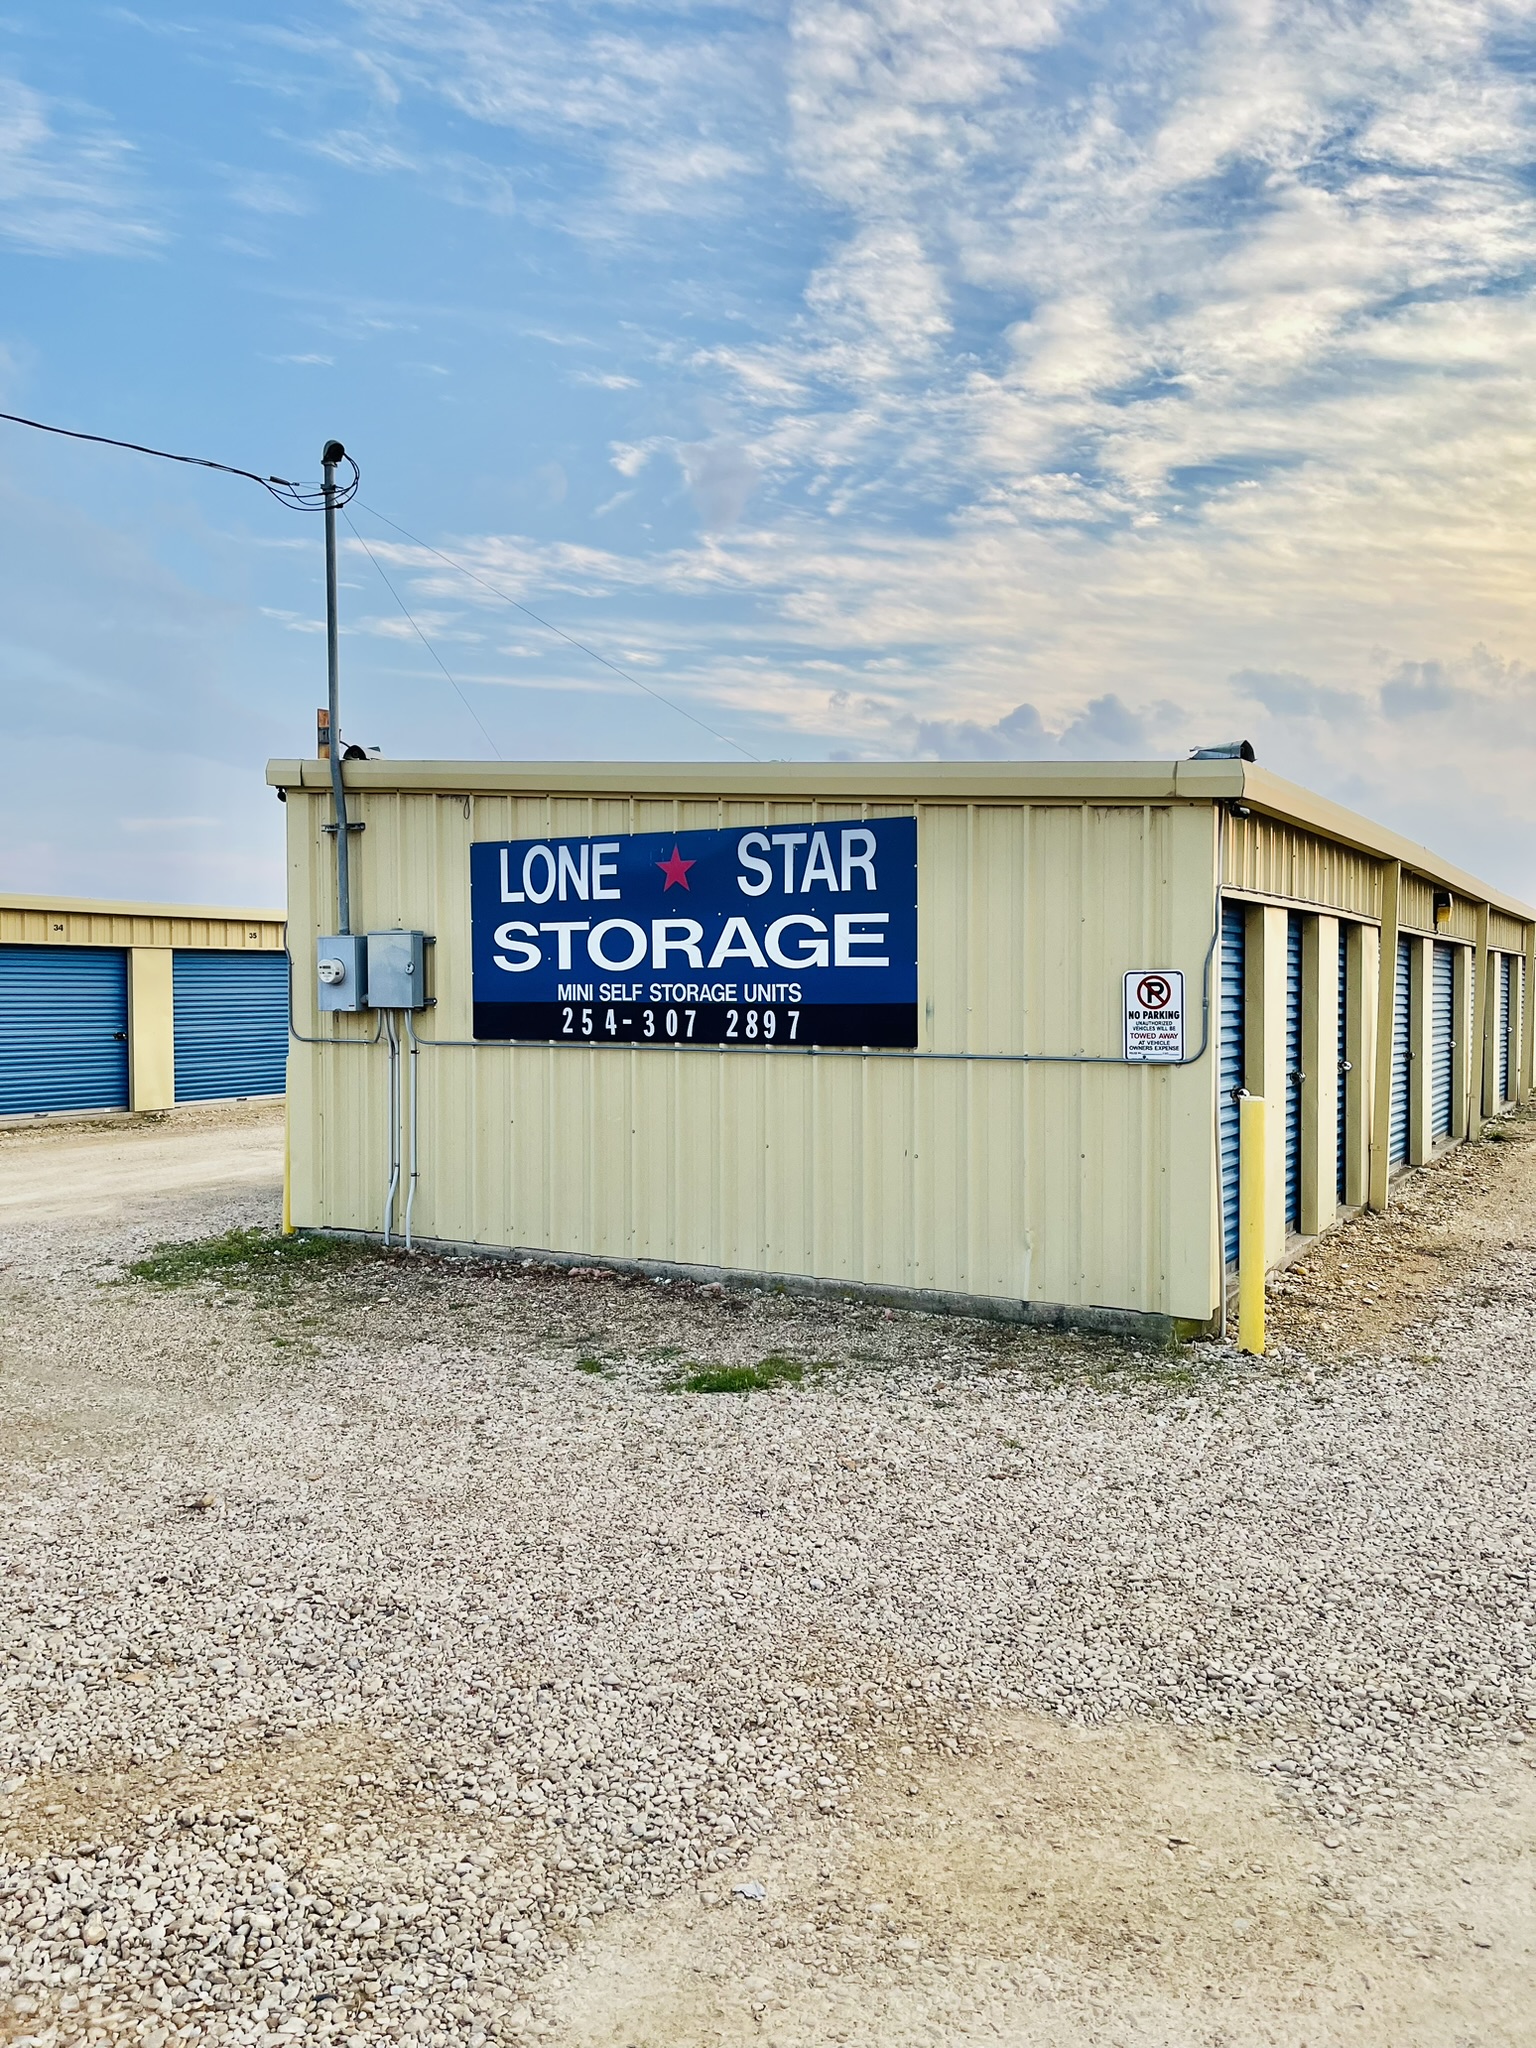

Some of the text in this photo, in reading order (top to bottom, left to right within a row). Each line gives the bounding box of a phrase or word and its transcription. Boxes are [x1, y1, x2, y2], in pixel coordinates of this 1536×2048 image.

[500, 828, 877, 904] LONE STAR
[493, 912, 890, 972] STORAGE
[557, 983, 802, 1003] MINI SELF STORAGE UNITS
[726, 1009, 801, 1040] 2897
[1128, 1011, 1180, 1020] NO PARKING
